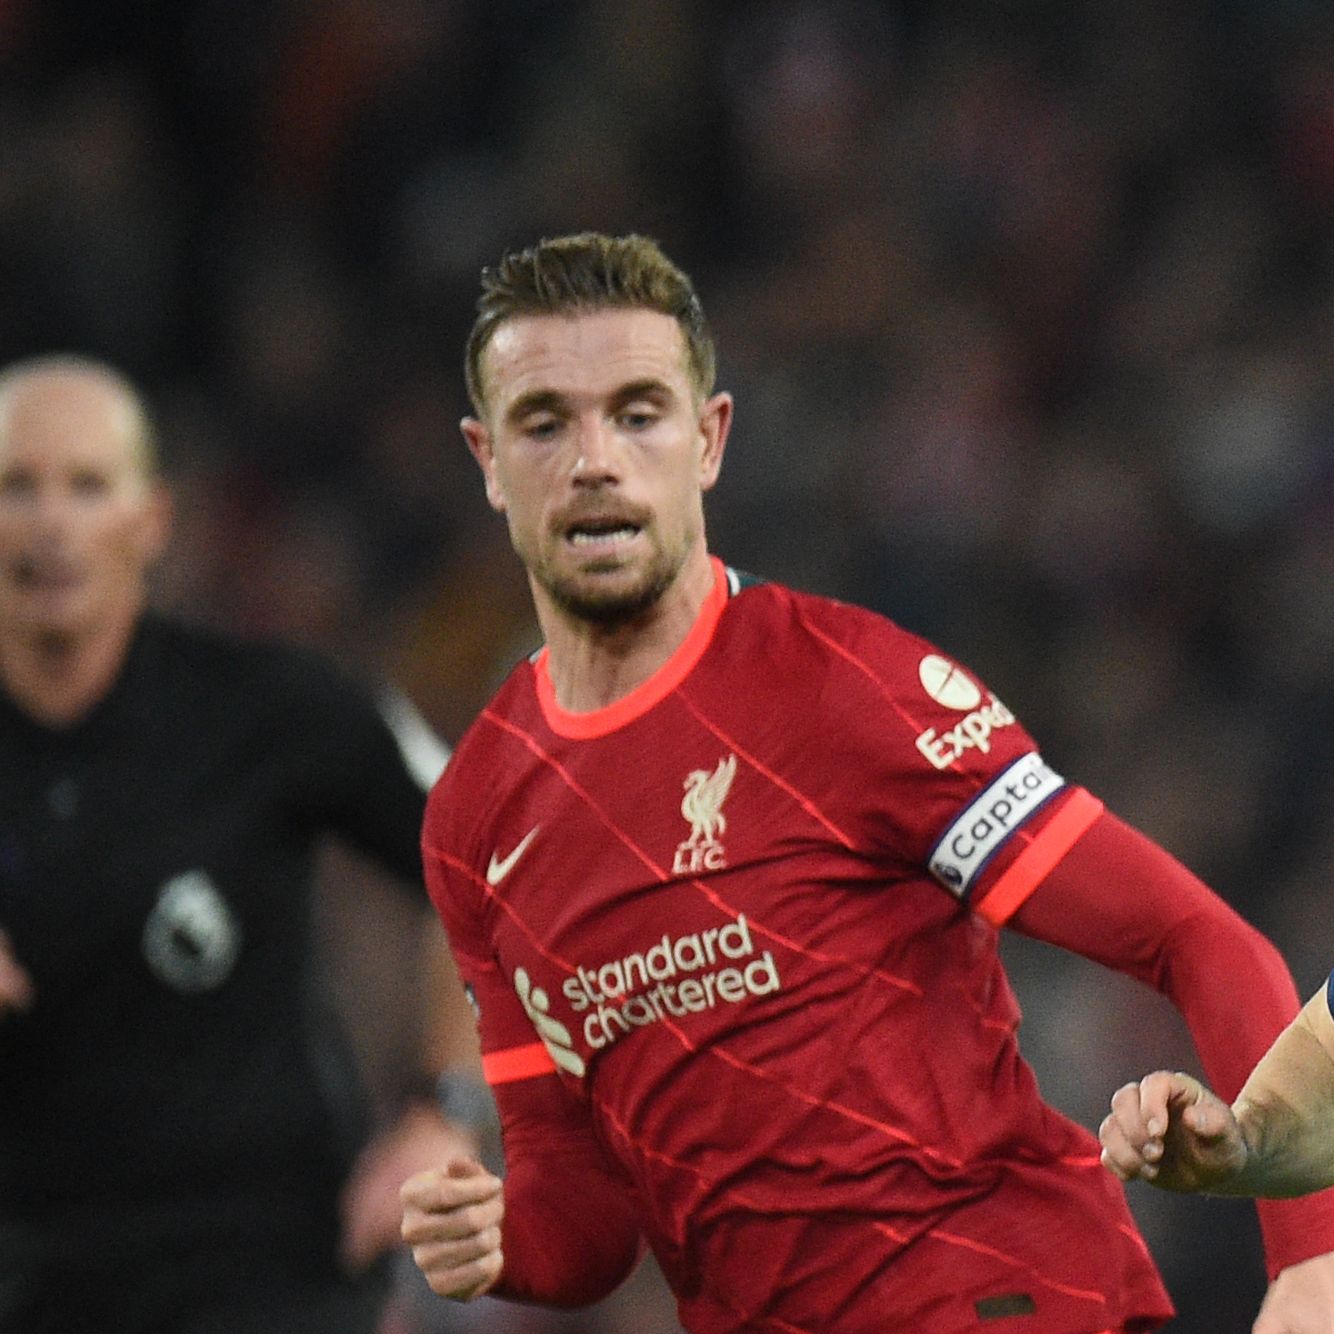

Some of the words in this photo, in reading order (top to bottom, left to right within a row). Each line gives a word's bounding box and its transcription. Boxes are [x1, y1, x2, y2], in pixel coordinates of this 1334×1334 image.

[673, 841, 726, 874] LFC
[562, 912, 753, 1012] standard
[583, 950, 780, 1049] chartered
